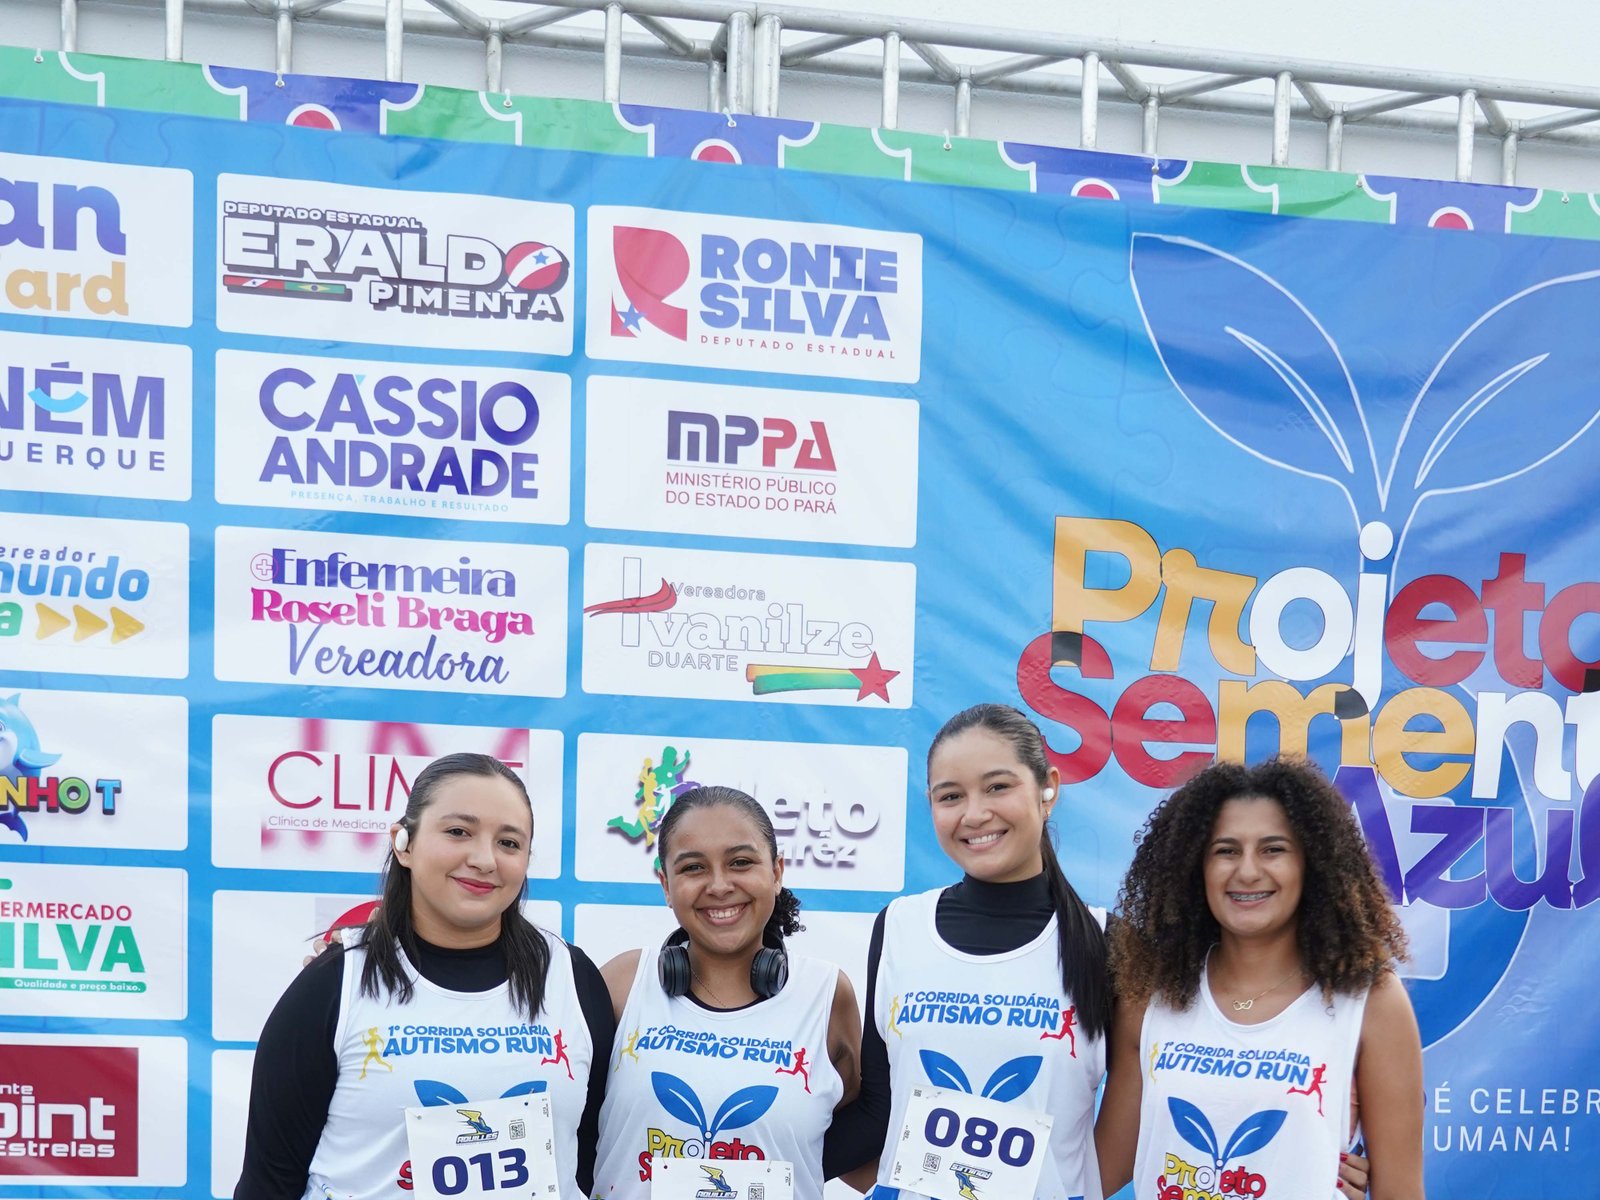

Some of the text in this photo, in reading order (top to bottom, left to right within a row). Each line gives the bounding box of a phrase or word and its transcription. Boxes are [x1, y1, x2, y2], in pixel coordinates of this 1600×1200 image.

[224, 201, 423, 229] DEPUTADO ESTADUAL
[223, 216, 568, 294] ERALDO
[701, 234, 898, 293] RONIE
[5, 261, 129, 316] ard
[369, 280, 564, 322] PIMENTA
[700, 282, 891, 341] SILVA
[701, 335, 896, 359] DEPUTADO ESTADUAL
[667, 410, 837, 471] MPPA
[0, 441, 165, 472] UERQUE
[259, 435, 539, 499] ANDRADE
[666, 471, 836, 496] MINISTÉRIO PÚBLICO
[291, 490, 509, 512] PRESENÇA, TRABALHO E RESULTADO
[665, 490, 837, 514] DO ESTADO DO PARÁ
[272, 548, 516, 597] Enfermeira
[671, 582, 766, 601] Vereadora
[251, 587, 535, 643] Roseli Braga
[289, 622, 510, 684] Vereadora
[648, 651, 738, 671] DUARTE
[268, 815, 386, 830] Clínica de Medicina
[1, 902, 132, 921] ERMERCADO
[0, 922, 145, 973] ILVA
[14, 979, 67, 990] Qualidade
[79, 982, 107, 992] preço
[110, 982, 141, 991] baixo.
[915, 991, 980, 1005] CORRIDA
[983, 993, 1060, 1010] SOLIDÁRIA
[403, 1025, 473, 1037] CORRIDA
[477, 1023, 550, 1037] SOLIDÁRIA
[896, 1004, 1059, 1030] AUTISMO RUN
[383, 1036, 552, 1057] AUTISMO RUN
[635, 1035, 792, 1067] AUTISMO RUN
[658, 1025, 717, 1042] CORRIDA
[720, 1036, 792, 1051] SOLIDÁRIA
[1155, 1053, 1308, 1086] AUTISMO RUN
[1175, 1043, 1234, 1058] CORRIDA
[1237, 1048, 1310, 1066] SOLIDÁRIA
[1434, 1081, 1600, 1115] É CELEBR
[924, 1107, 1035, 1167] 080
[1422, 1125, 1571, 1152] UMANA!
[432, 1148, 529, 1196] 013
[1164, 1152, 1266, 1198] Projeto
